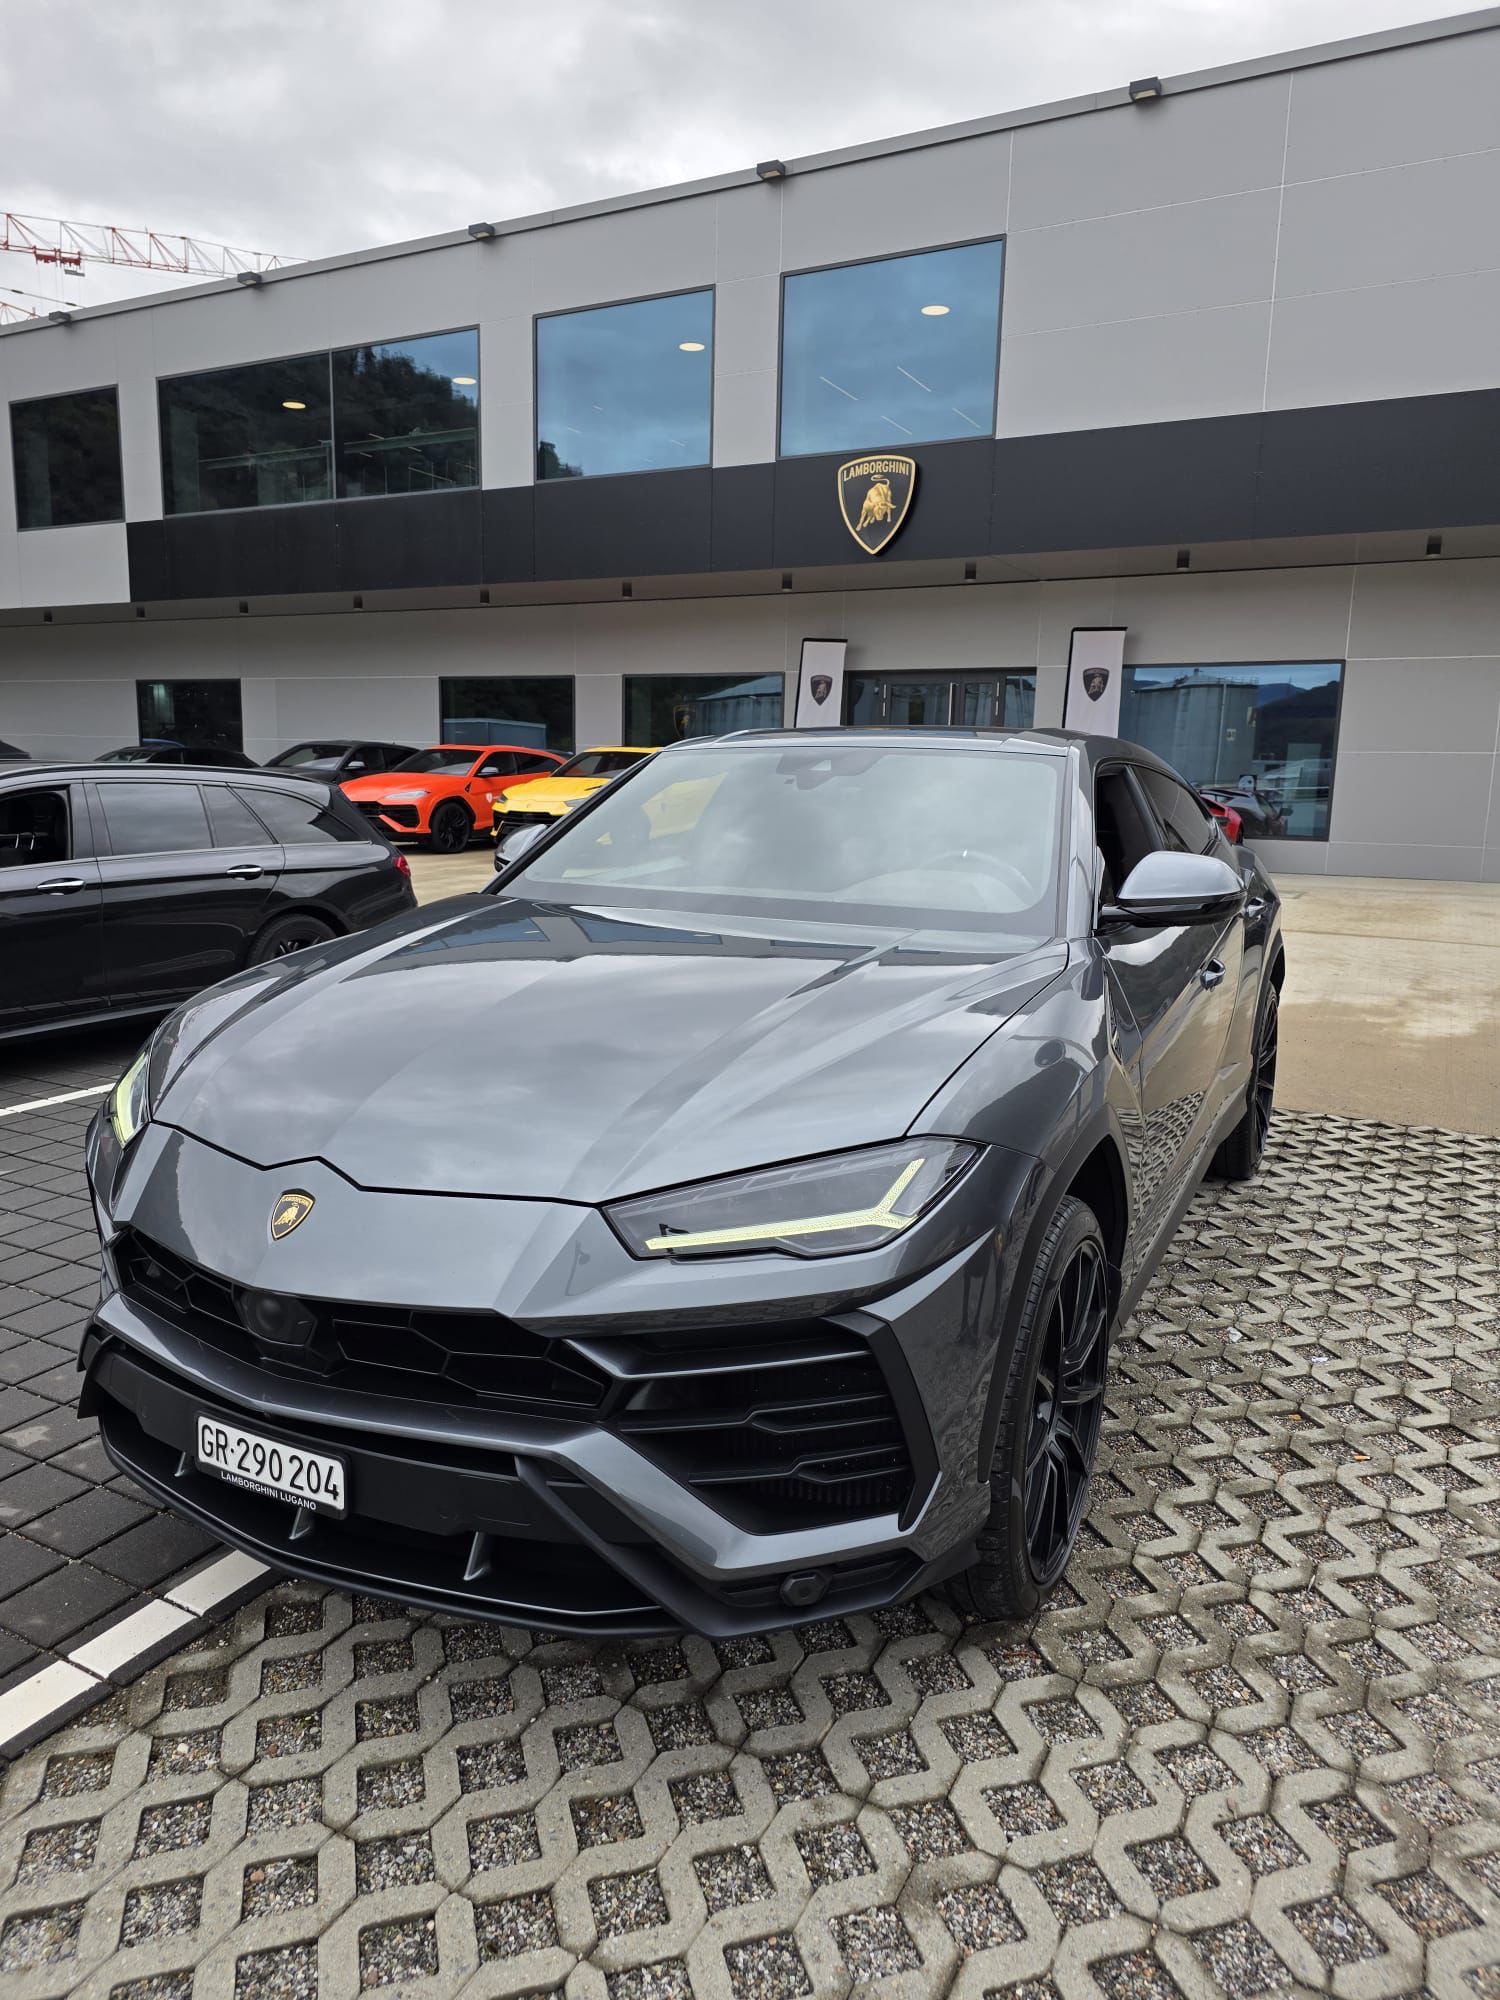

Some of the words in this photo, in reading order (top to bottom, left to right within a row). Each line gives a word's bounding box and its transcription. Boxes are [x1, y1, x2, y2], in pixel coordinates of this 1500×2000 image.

[843, 460, 909, 482] LAMBORGHINI
[220, 1470, 278, 1499] LAMBORGHINI
[280, 1492, 317, 1511] LUGANO
[289, 1454, 340, 1500] 204
